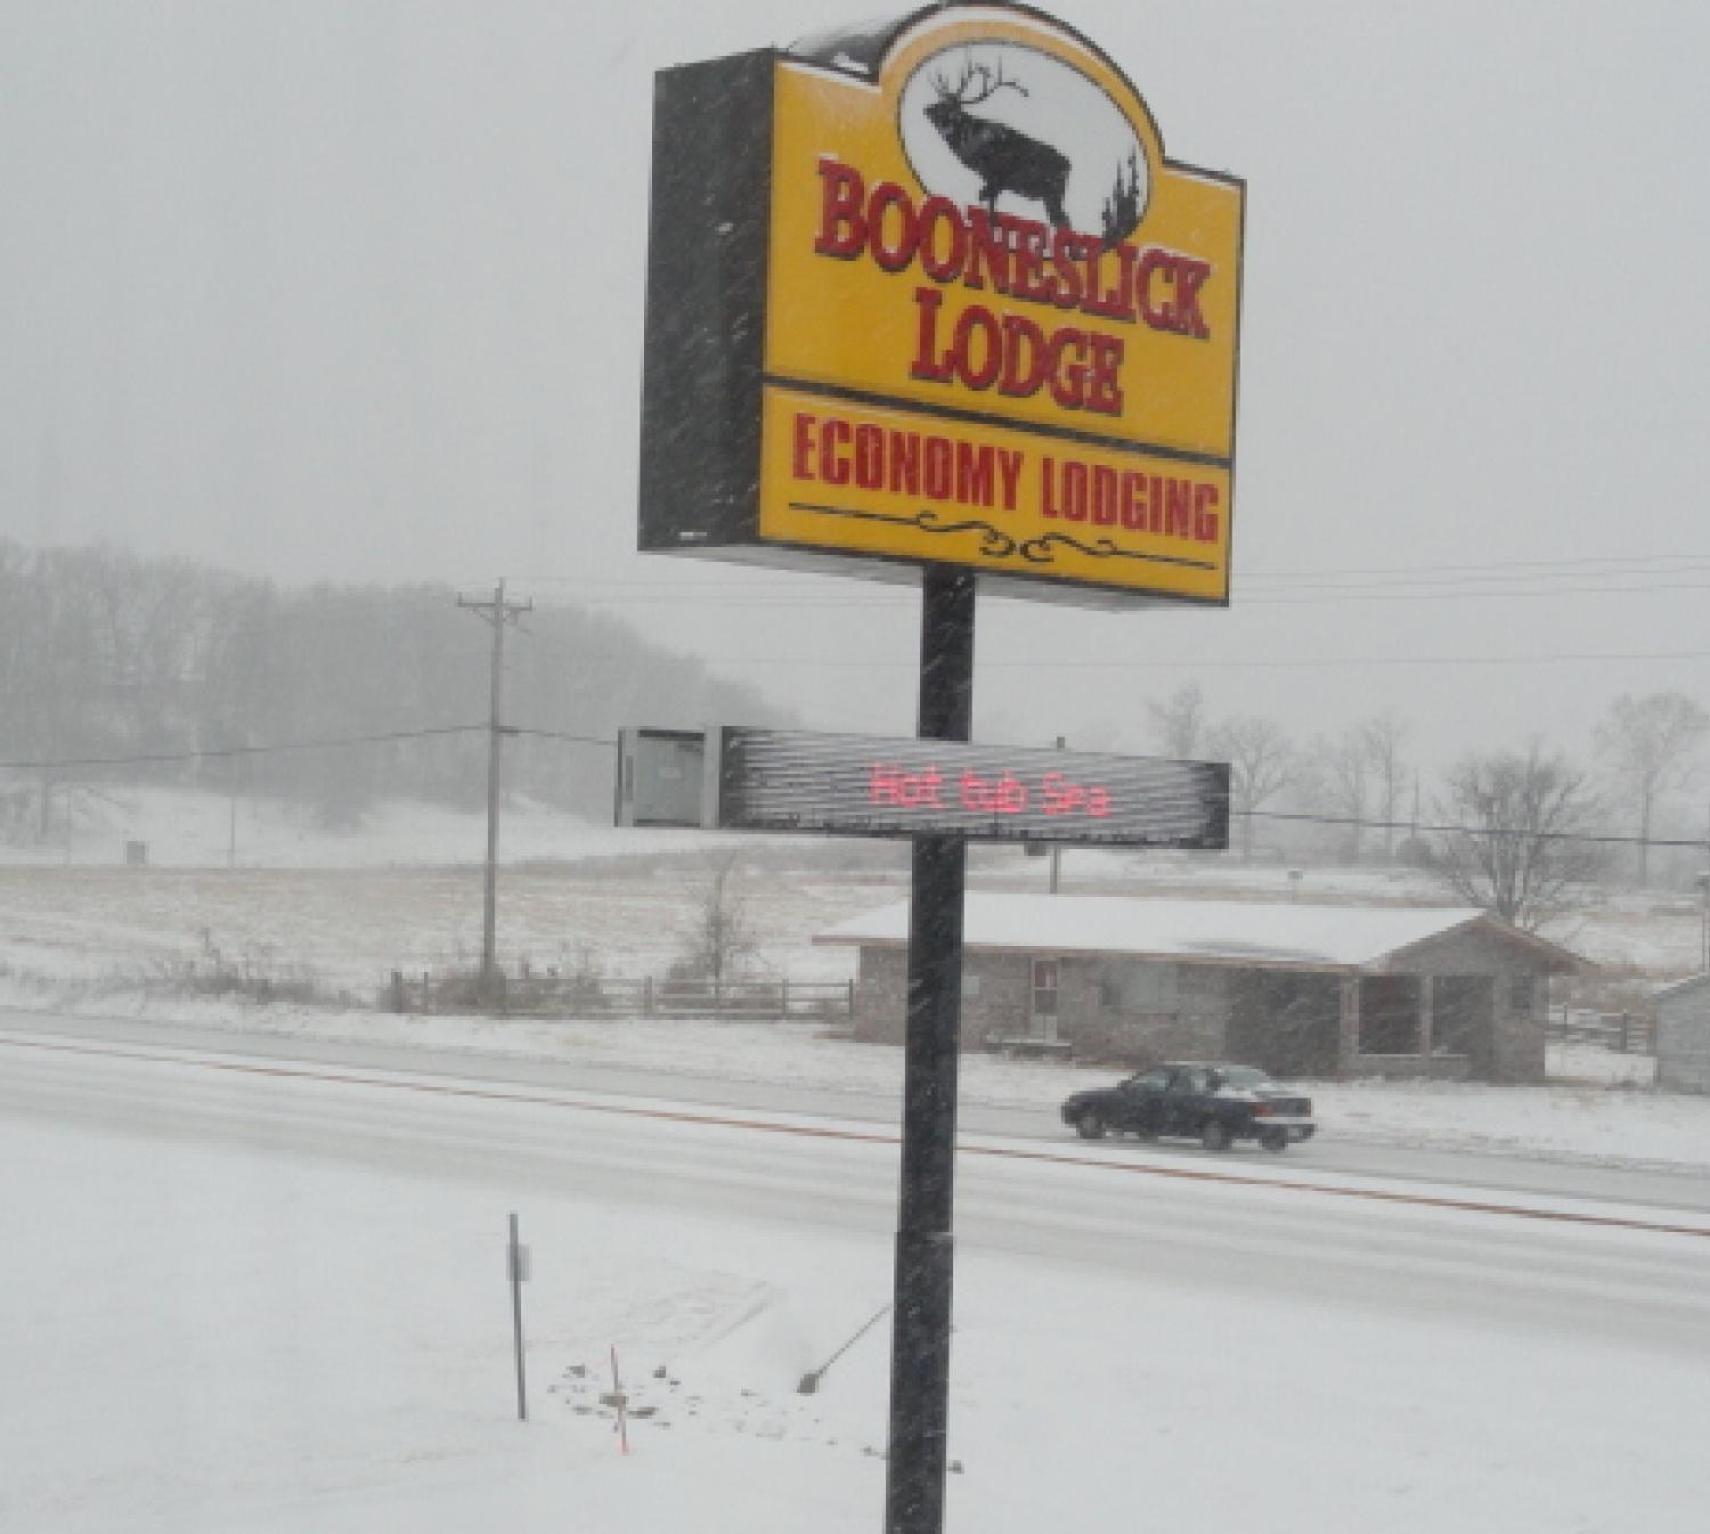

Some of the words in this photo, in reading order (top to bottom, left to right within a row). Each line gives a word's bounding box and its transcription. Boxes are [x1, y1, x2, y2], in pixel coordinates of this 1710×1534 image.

[814, 158, 1211, 339] BOONESLICK
[910, 286, 1125, 416] LODGE
[792, 412, 1024, 511] ECONOMY
[1041, 456, 1219, 543] LODGING
[868, 761, 943, 809] Hot
[958, 768, 1028, 814] tub
[1040, 771, 1112, 818] Spa
